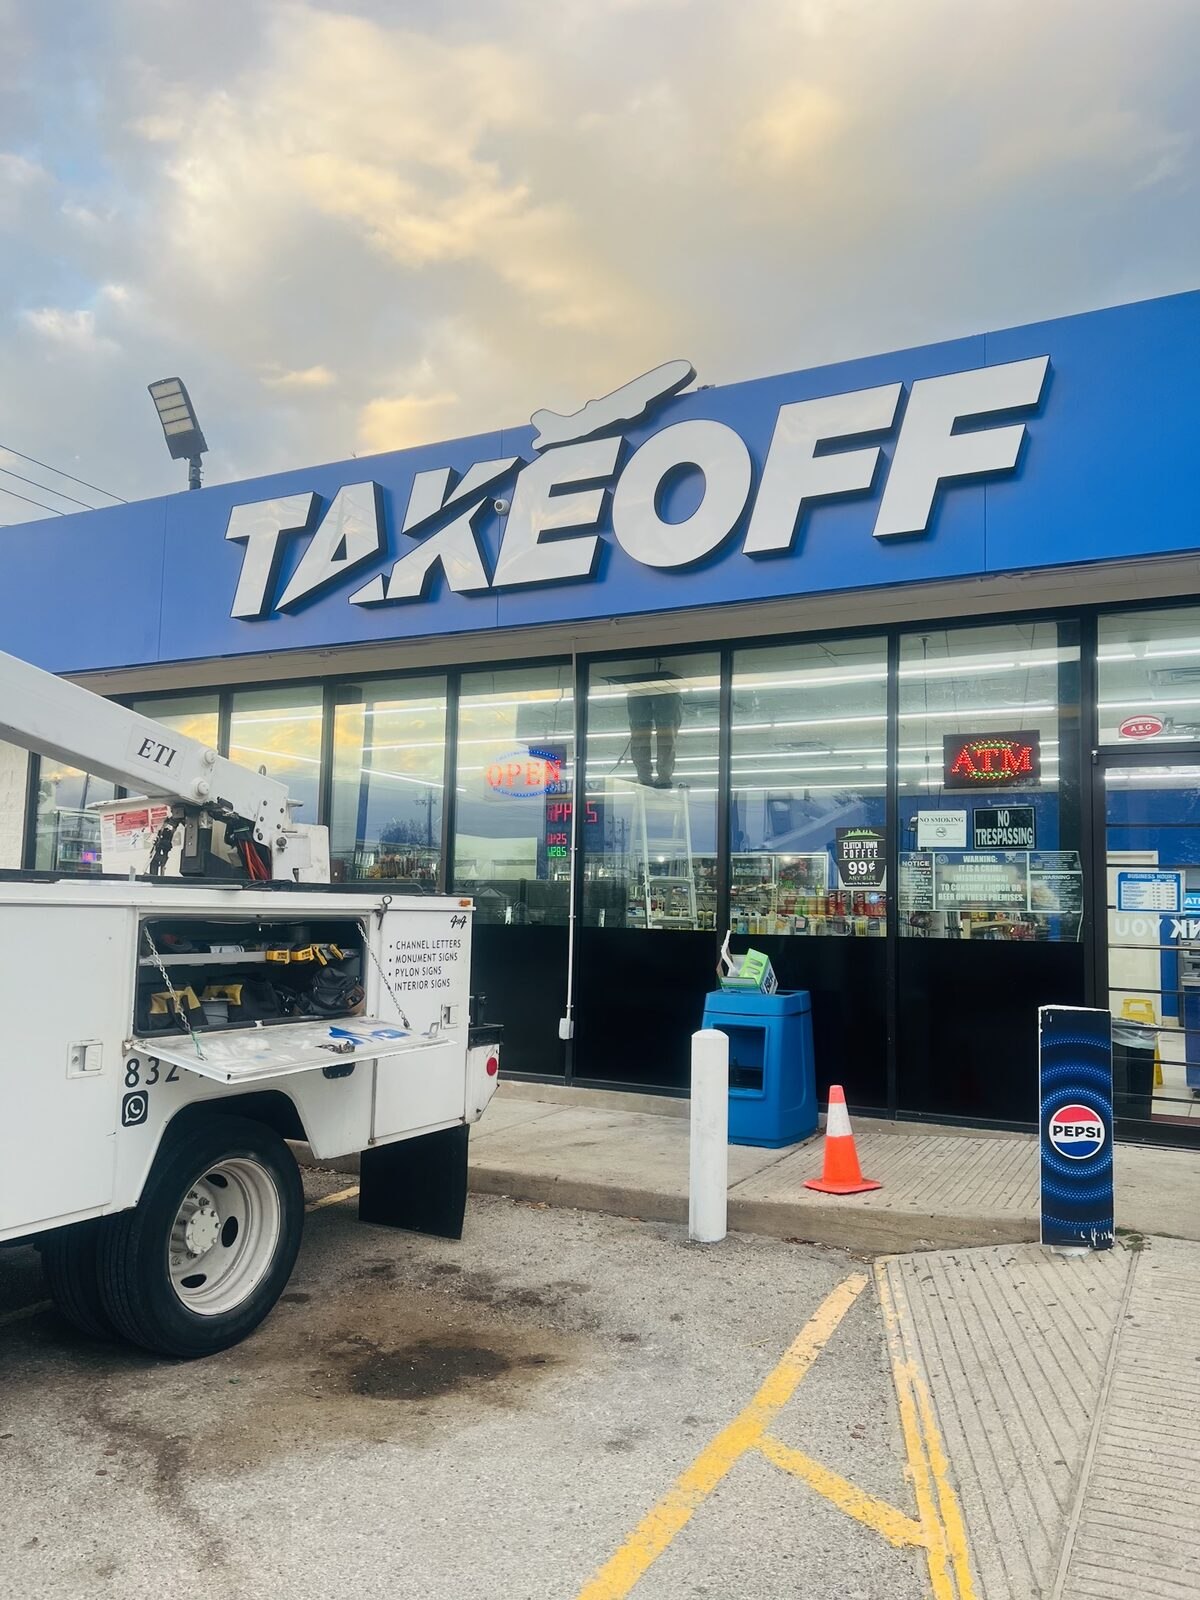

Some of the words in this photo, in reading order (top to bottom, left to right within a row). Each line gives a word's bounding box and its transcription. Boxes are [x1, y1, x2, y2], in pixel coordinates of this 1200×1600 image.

[225, 354, 1051, 622] TAKEOFF
[136, 737, 177, 768] ETI
[951, 746, 1033, 773] ATM
[486, 760, 561, 788] OPEN
[998, 810, 1010, 827] NO
[975, 827, 1033, 845] TRESPASSING
[843, 849, 878, 859] COFFEE
[962, 855, 998, 863] WARNING:
[848, 860, 876, 875] 99¢
[958, 864, 965, 873] IT
[966, 864, 974, 873] IS
[974, 864, 980, 873] A
[980, 864, 1003, 873] CRIME
[941, 883, 950, 892] TO
[950, 883, 985, 892] CONSUME
[985, 884, 1010, 892] LIQUOR
[1011, 884, 1022, 892] OR
[937, 893, 955, 901] BEER
[955, 893, 966, 901] ON
[967, 893, 988, 902] THESE
[988, 893, 1025, 902] PREMISES.
[1184, 897, 1200, 905] AT
[395, 940, 430, 950] CHANNEL
[432, 939, 461, 949] LETTERS
[395, 953, 436, 964] MONUMENT
[438, 952, 458, 962] SIGNS
[395, 967, 420, 977] PYLON
[422, 966, 442, 976] SIGNS
[394, 980, 429, 991] INTERIOR
[431, 978, 450, 989] SIGNS
[1053, 1125, 1101, 1139] PEPSI
